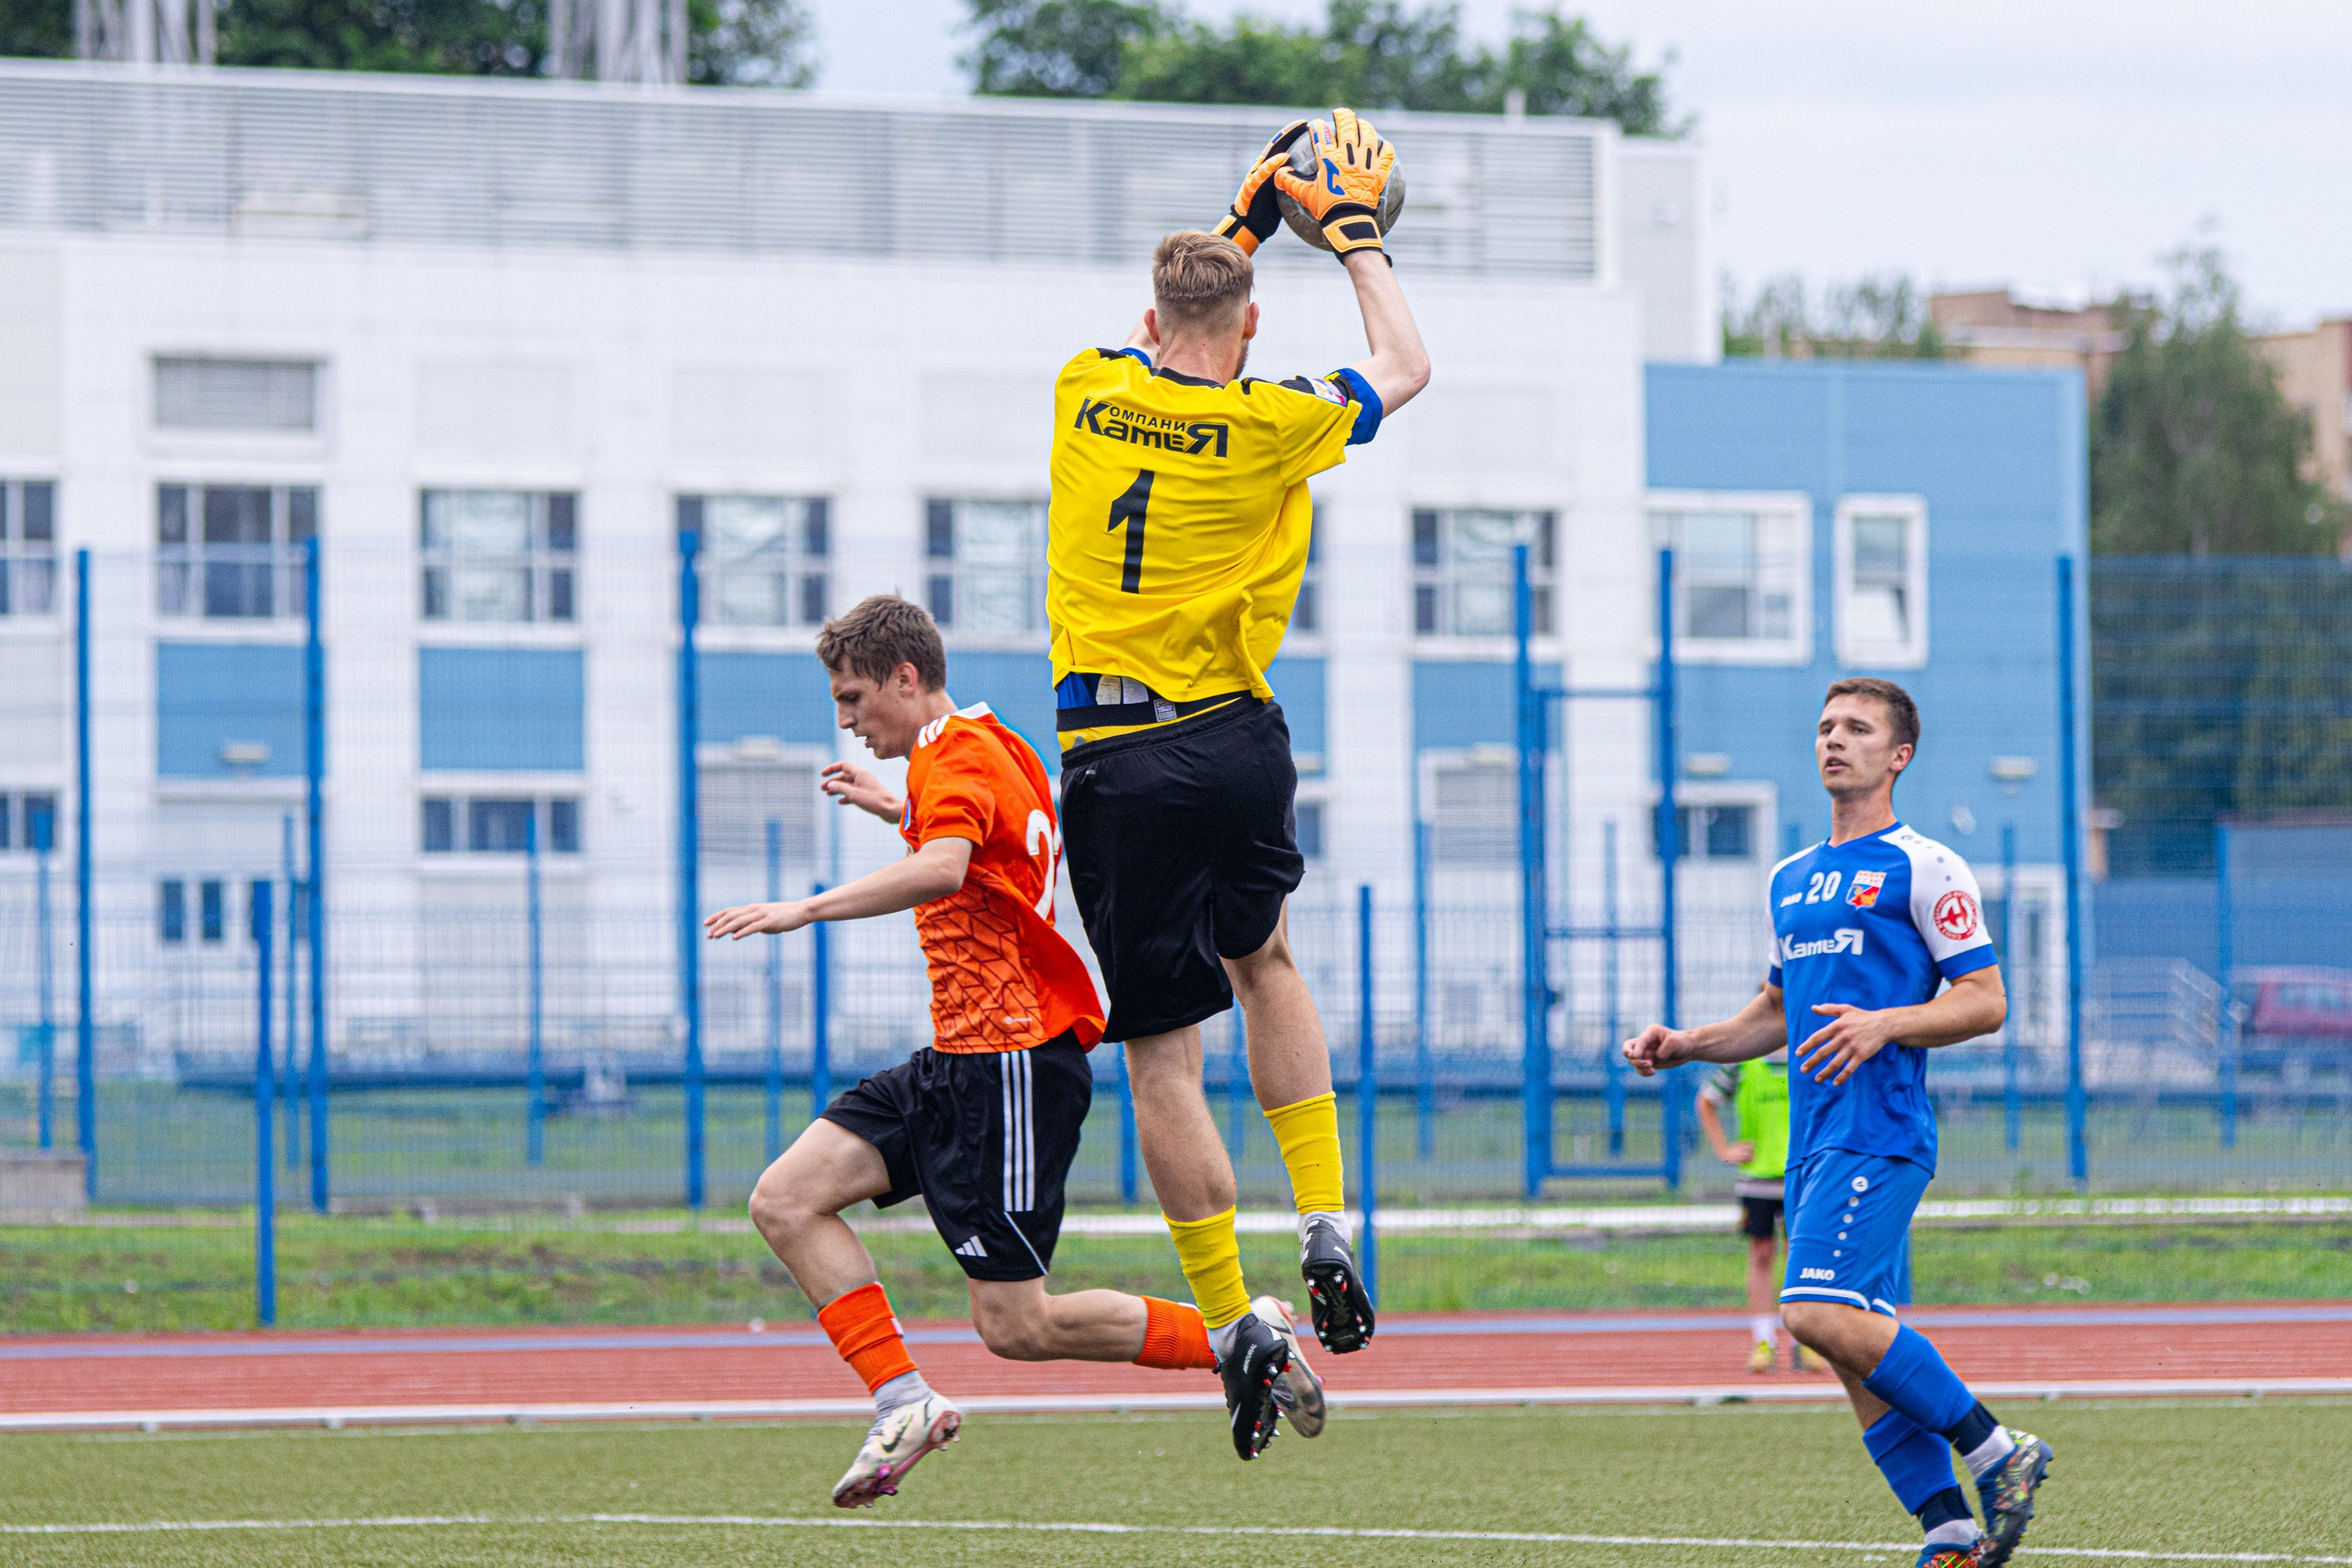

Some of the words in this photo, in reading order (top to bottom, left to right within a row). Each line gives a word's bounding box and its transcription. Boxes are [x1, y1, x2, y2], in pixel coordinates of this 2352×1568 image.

[1106, 469, 1155, 594] 1
[1025, 808, 1062, 921] 2
[1804, 870, 1842, 905] 20
[1800, 1268, 1836, 1280] JAKO
